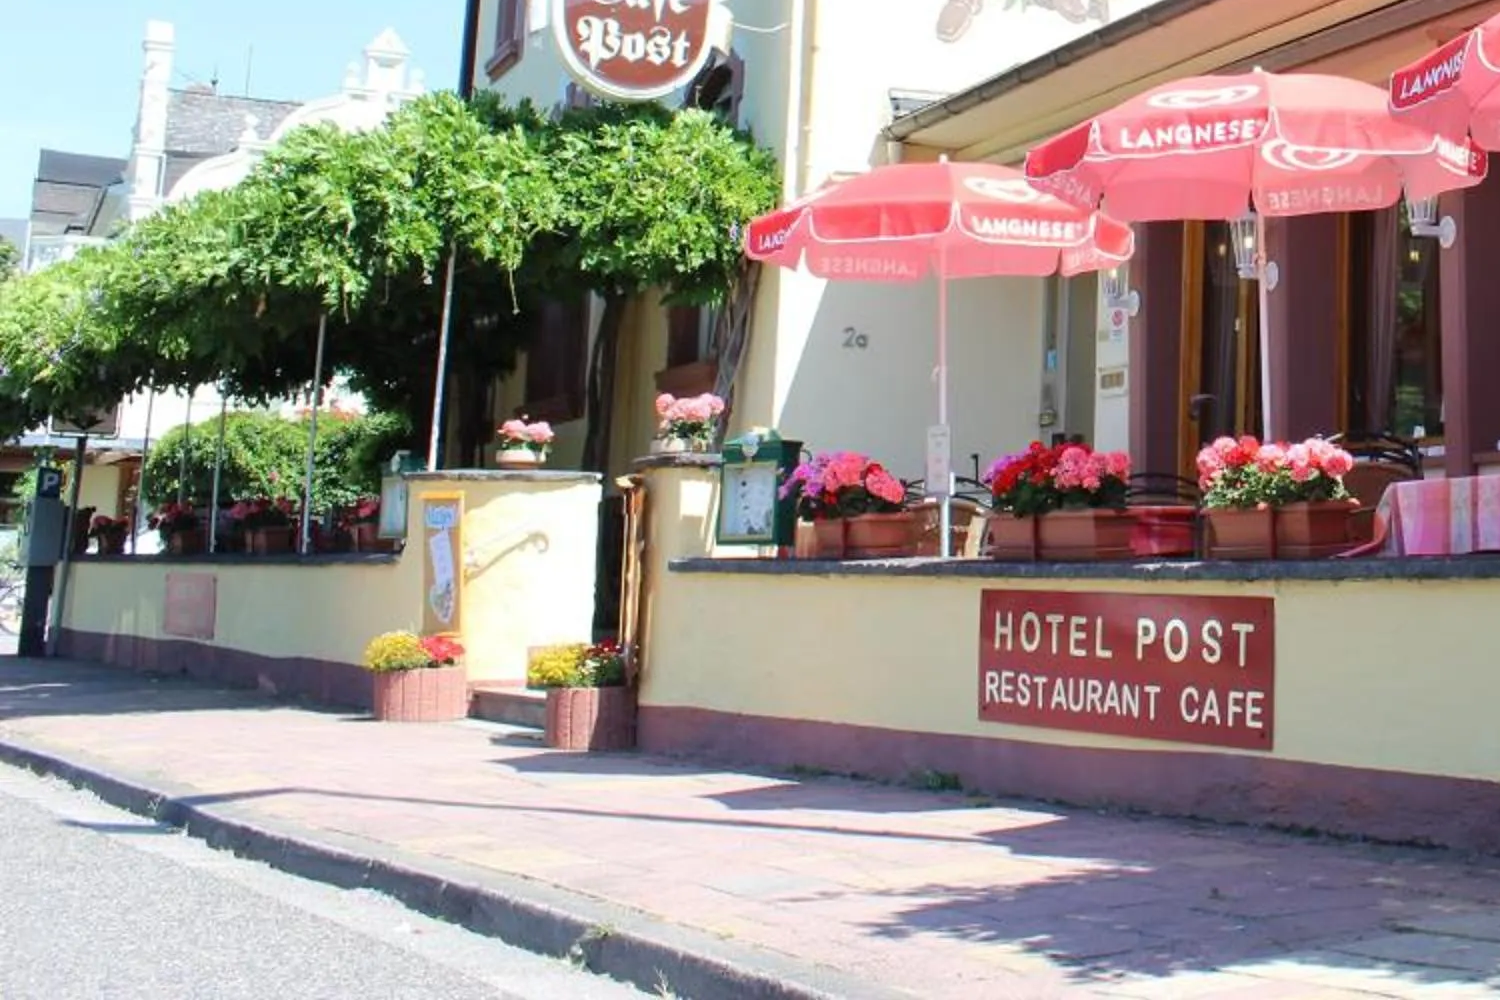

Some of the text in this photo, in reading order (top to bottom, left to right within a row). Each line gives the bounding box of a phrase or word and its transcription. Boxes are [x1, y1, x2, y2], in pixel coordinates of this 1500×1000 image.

[575, 15, 692, 71] Post
[1119, 118, 1257, 150] LANGNESE
[970, 214, 1076, 240] LANGNESE
[841, 326, 869, 350] 2a
[42, 471, 60, 491] P
[994, 610, 1255, 668] HOTEL POST
[985, 670, 1264, 729] RESTAURANT CAFE
